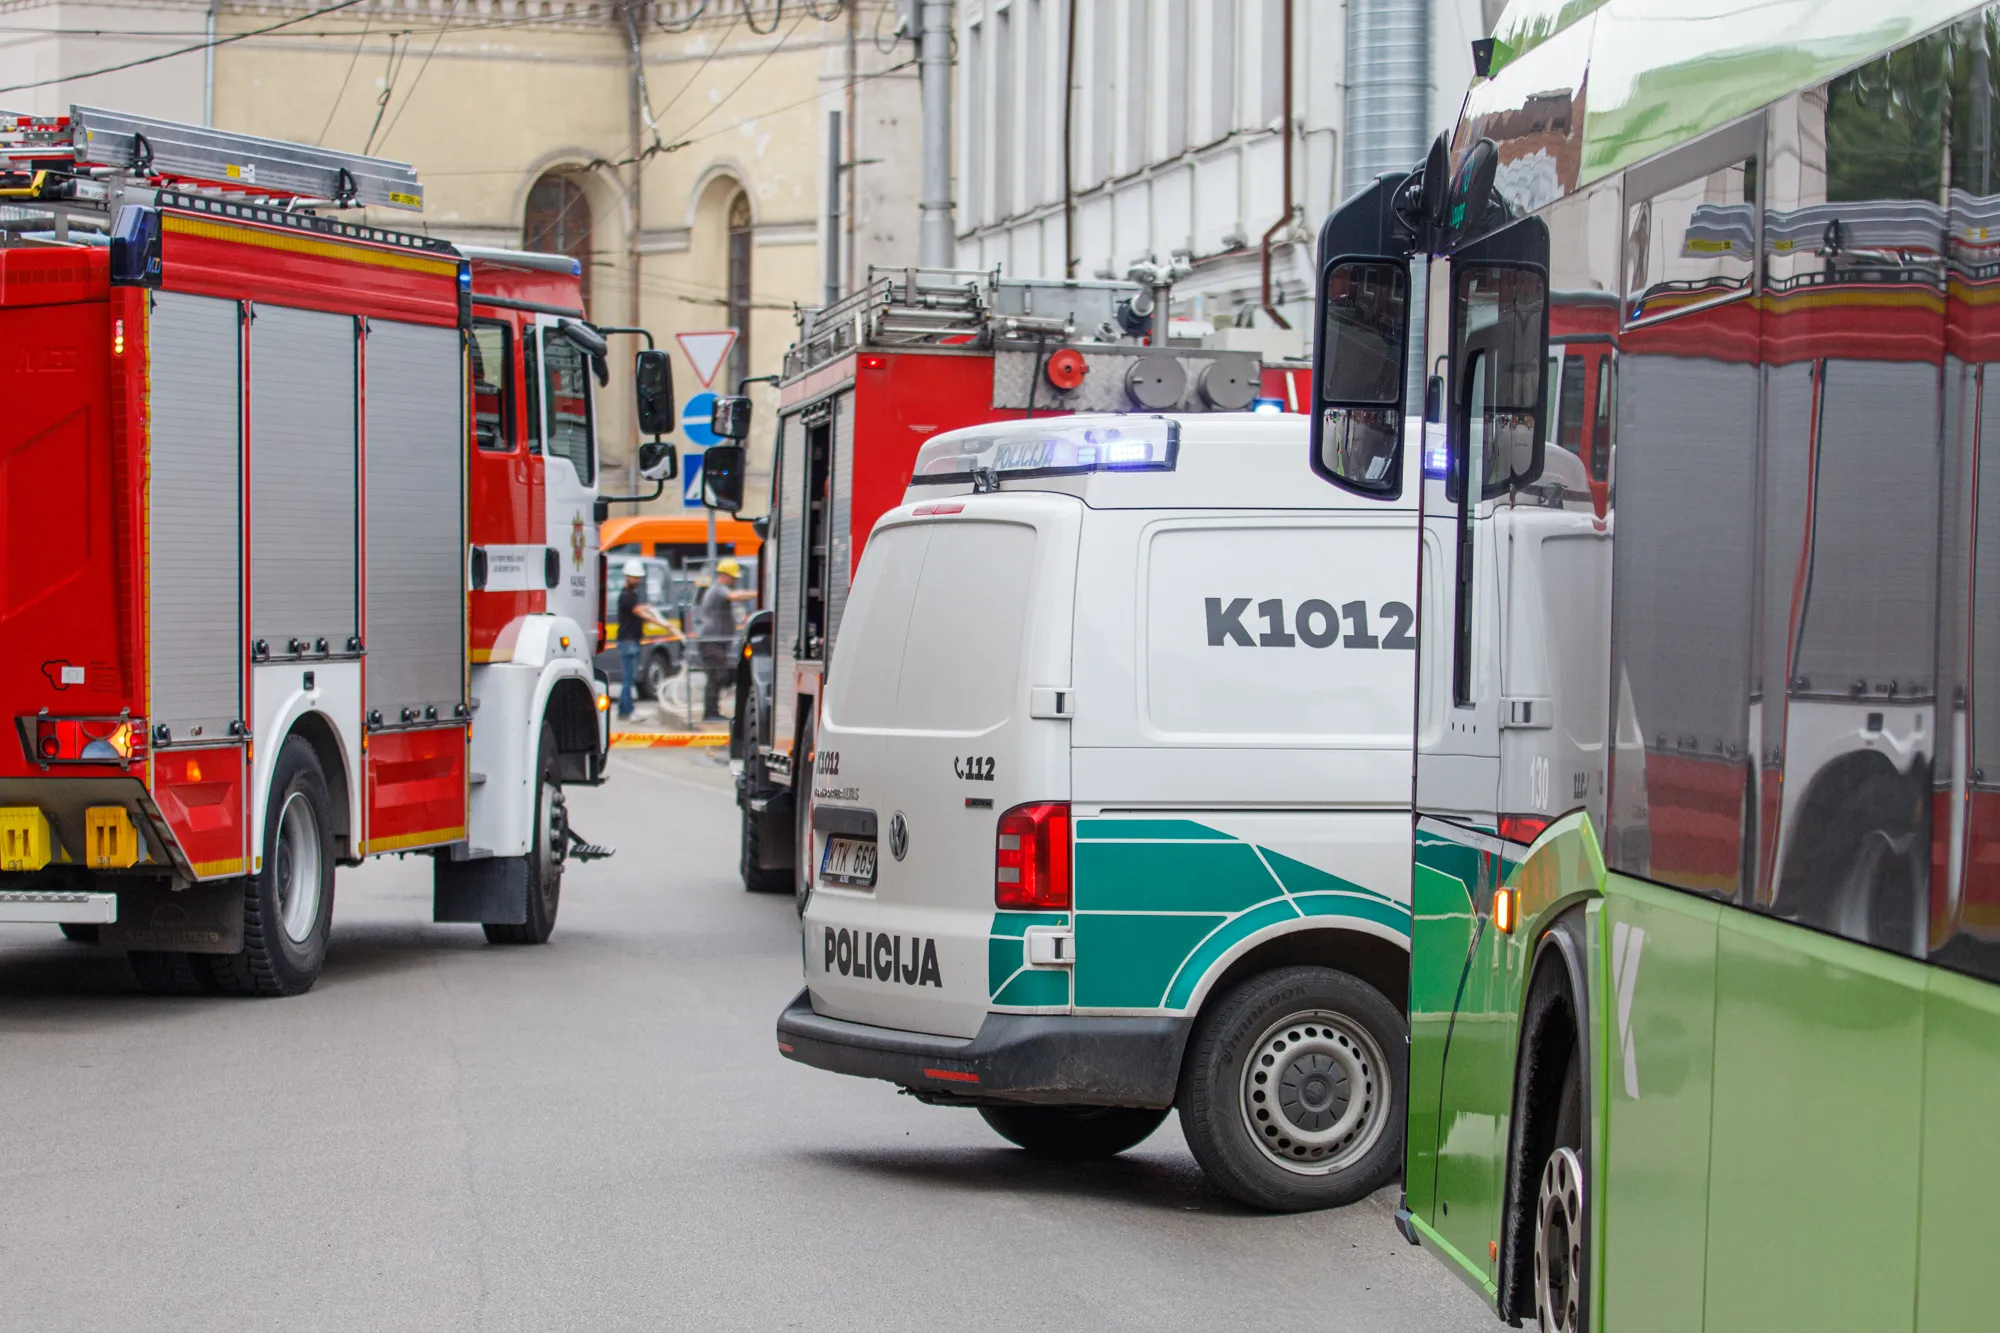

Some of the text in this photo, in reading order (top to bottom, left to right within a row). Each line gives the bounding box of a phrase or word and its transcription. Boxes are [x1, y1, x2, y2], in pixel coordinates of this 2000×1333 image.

[1204, 597, 1416, 650] K1012
[965, 756, 996, 781] 112
[1530, 755, 1549, 811] 130
[828, 840, 876, 875] KTK 669
[824, 926, 943, 988] POLICIJA
